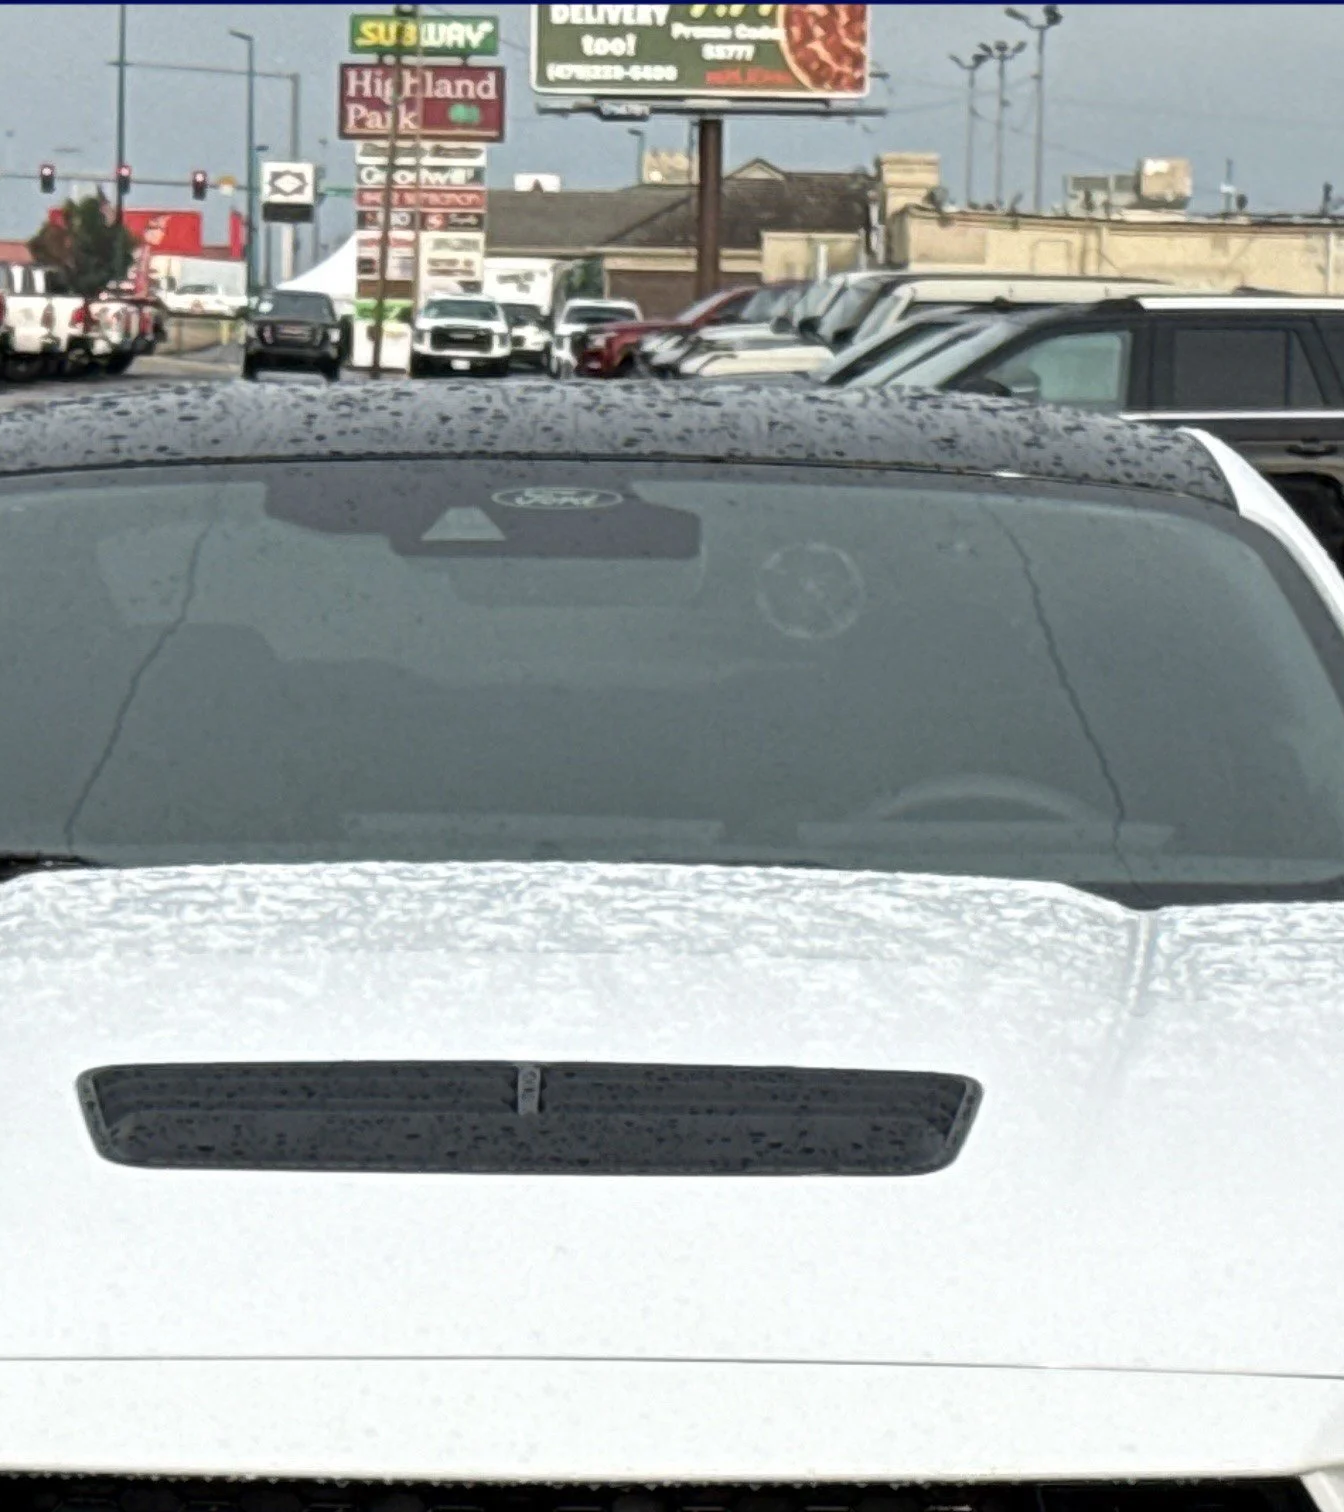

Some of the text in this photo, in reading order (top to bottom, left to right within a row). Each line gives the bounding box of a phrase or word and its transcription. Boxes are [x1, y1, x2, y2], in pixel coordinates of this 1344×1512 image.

[355, 20, 494, 49] SUBWAY
[580, 33, 637, 57] too!
[345, 69, 498, 104] Highland
